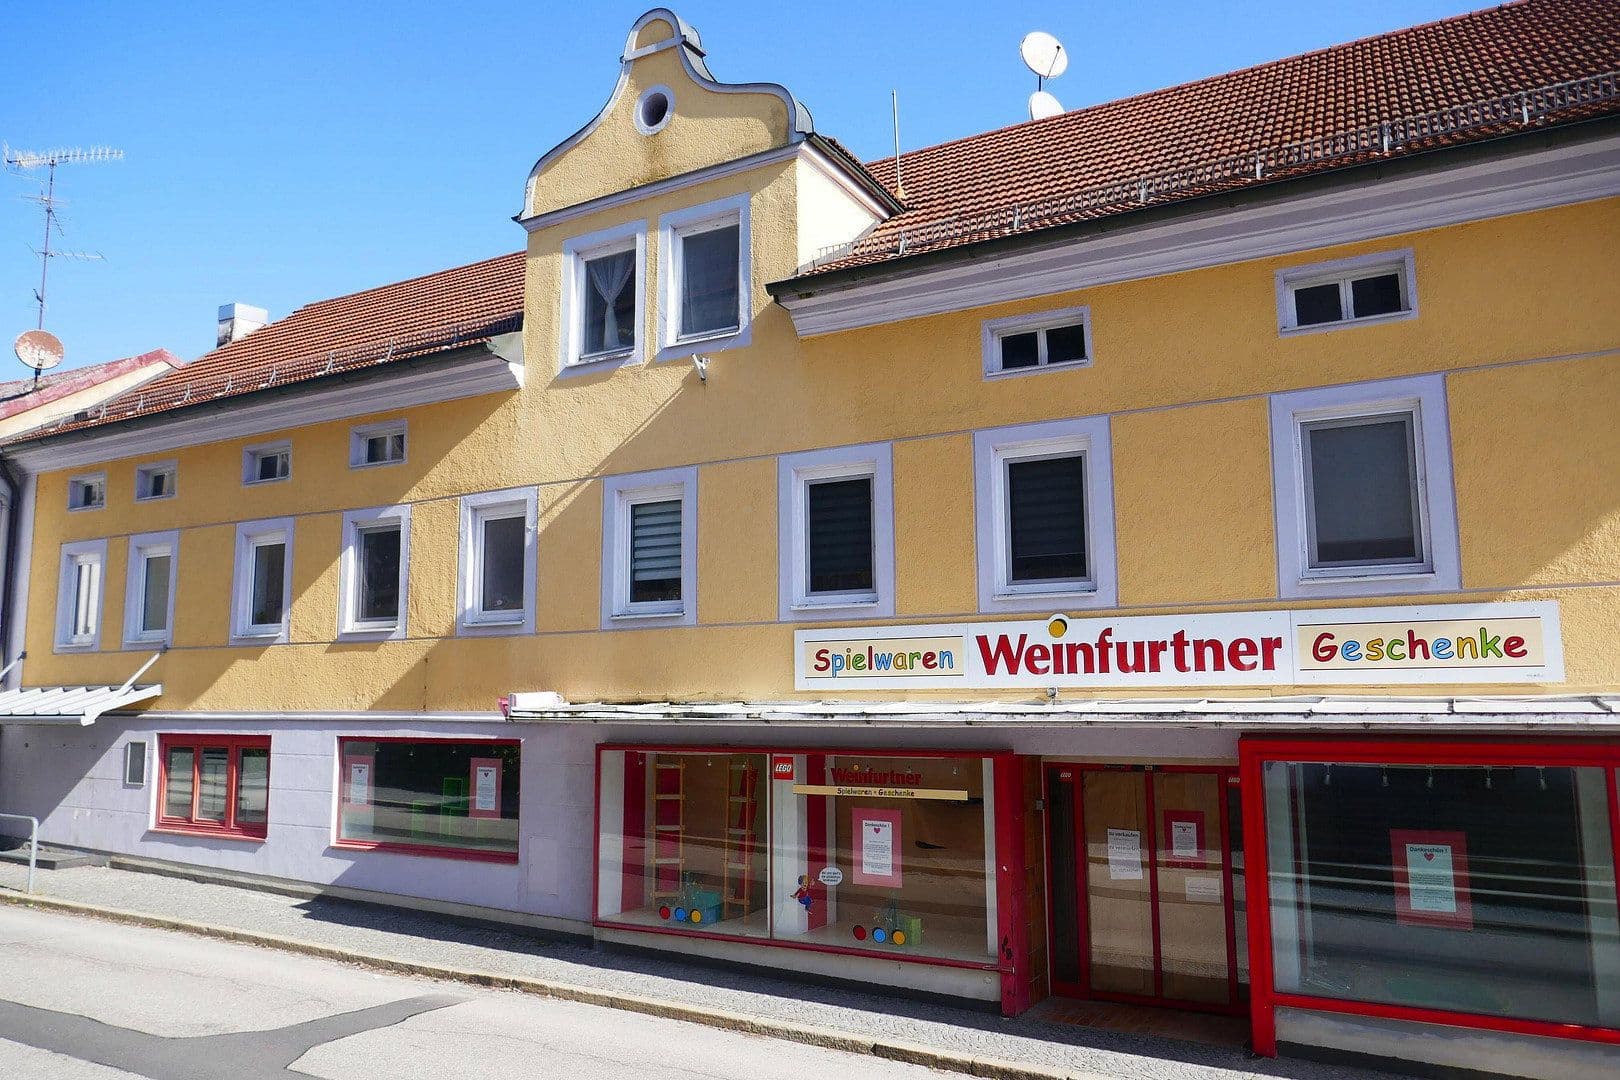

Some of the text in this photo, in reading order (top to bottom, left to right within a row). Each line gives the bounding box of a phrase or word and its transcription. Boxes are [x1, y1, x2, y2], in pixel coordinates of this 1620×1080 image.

[975, 627, 1282, 676] Weinfurtner
[1312, 627, 1528, 663] Geschenke
[813, 646, 954, 678] Spielwaren
[775, 764, 792, 772] LEGO
[831, 767, 922, 786] Weinfurtner
[837, 788, 915, 797] Spielwaren Geschenke
